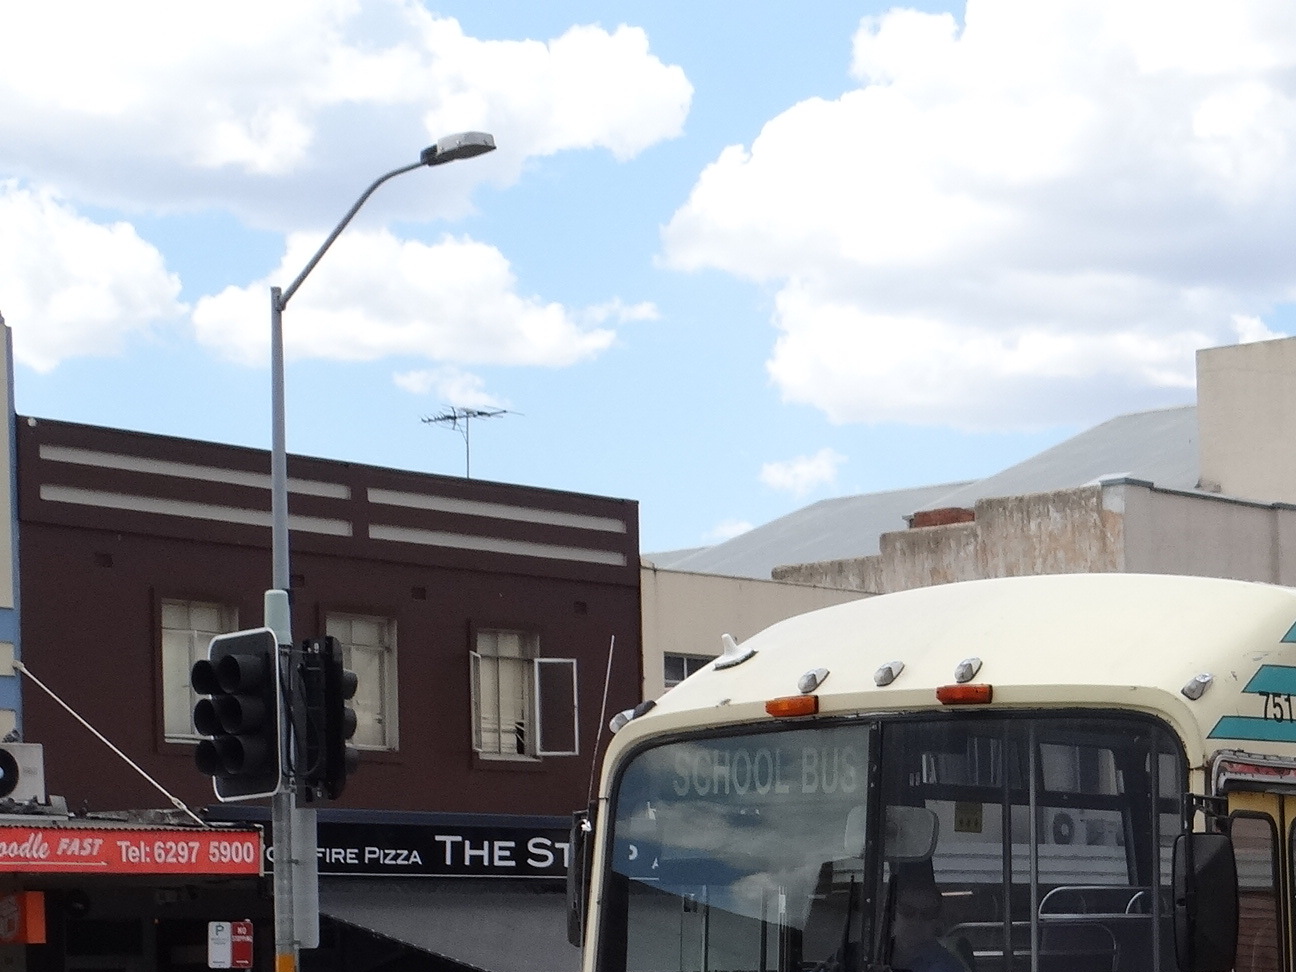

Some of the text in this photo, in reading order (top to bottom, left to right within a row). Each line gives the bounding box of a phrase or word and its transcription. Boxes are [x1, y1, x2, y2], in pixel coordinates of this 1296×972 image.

[672, 747, 858, 796] SCHOOL BUS
[0, 832, 254, 863] oodle FAST Tel: 6297 5900
[364, 846, 422, 865] PIZZA
[435, 835, 516, 866] THE
[527, 837, 569, 868] ST
